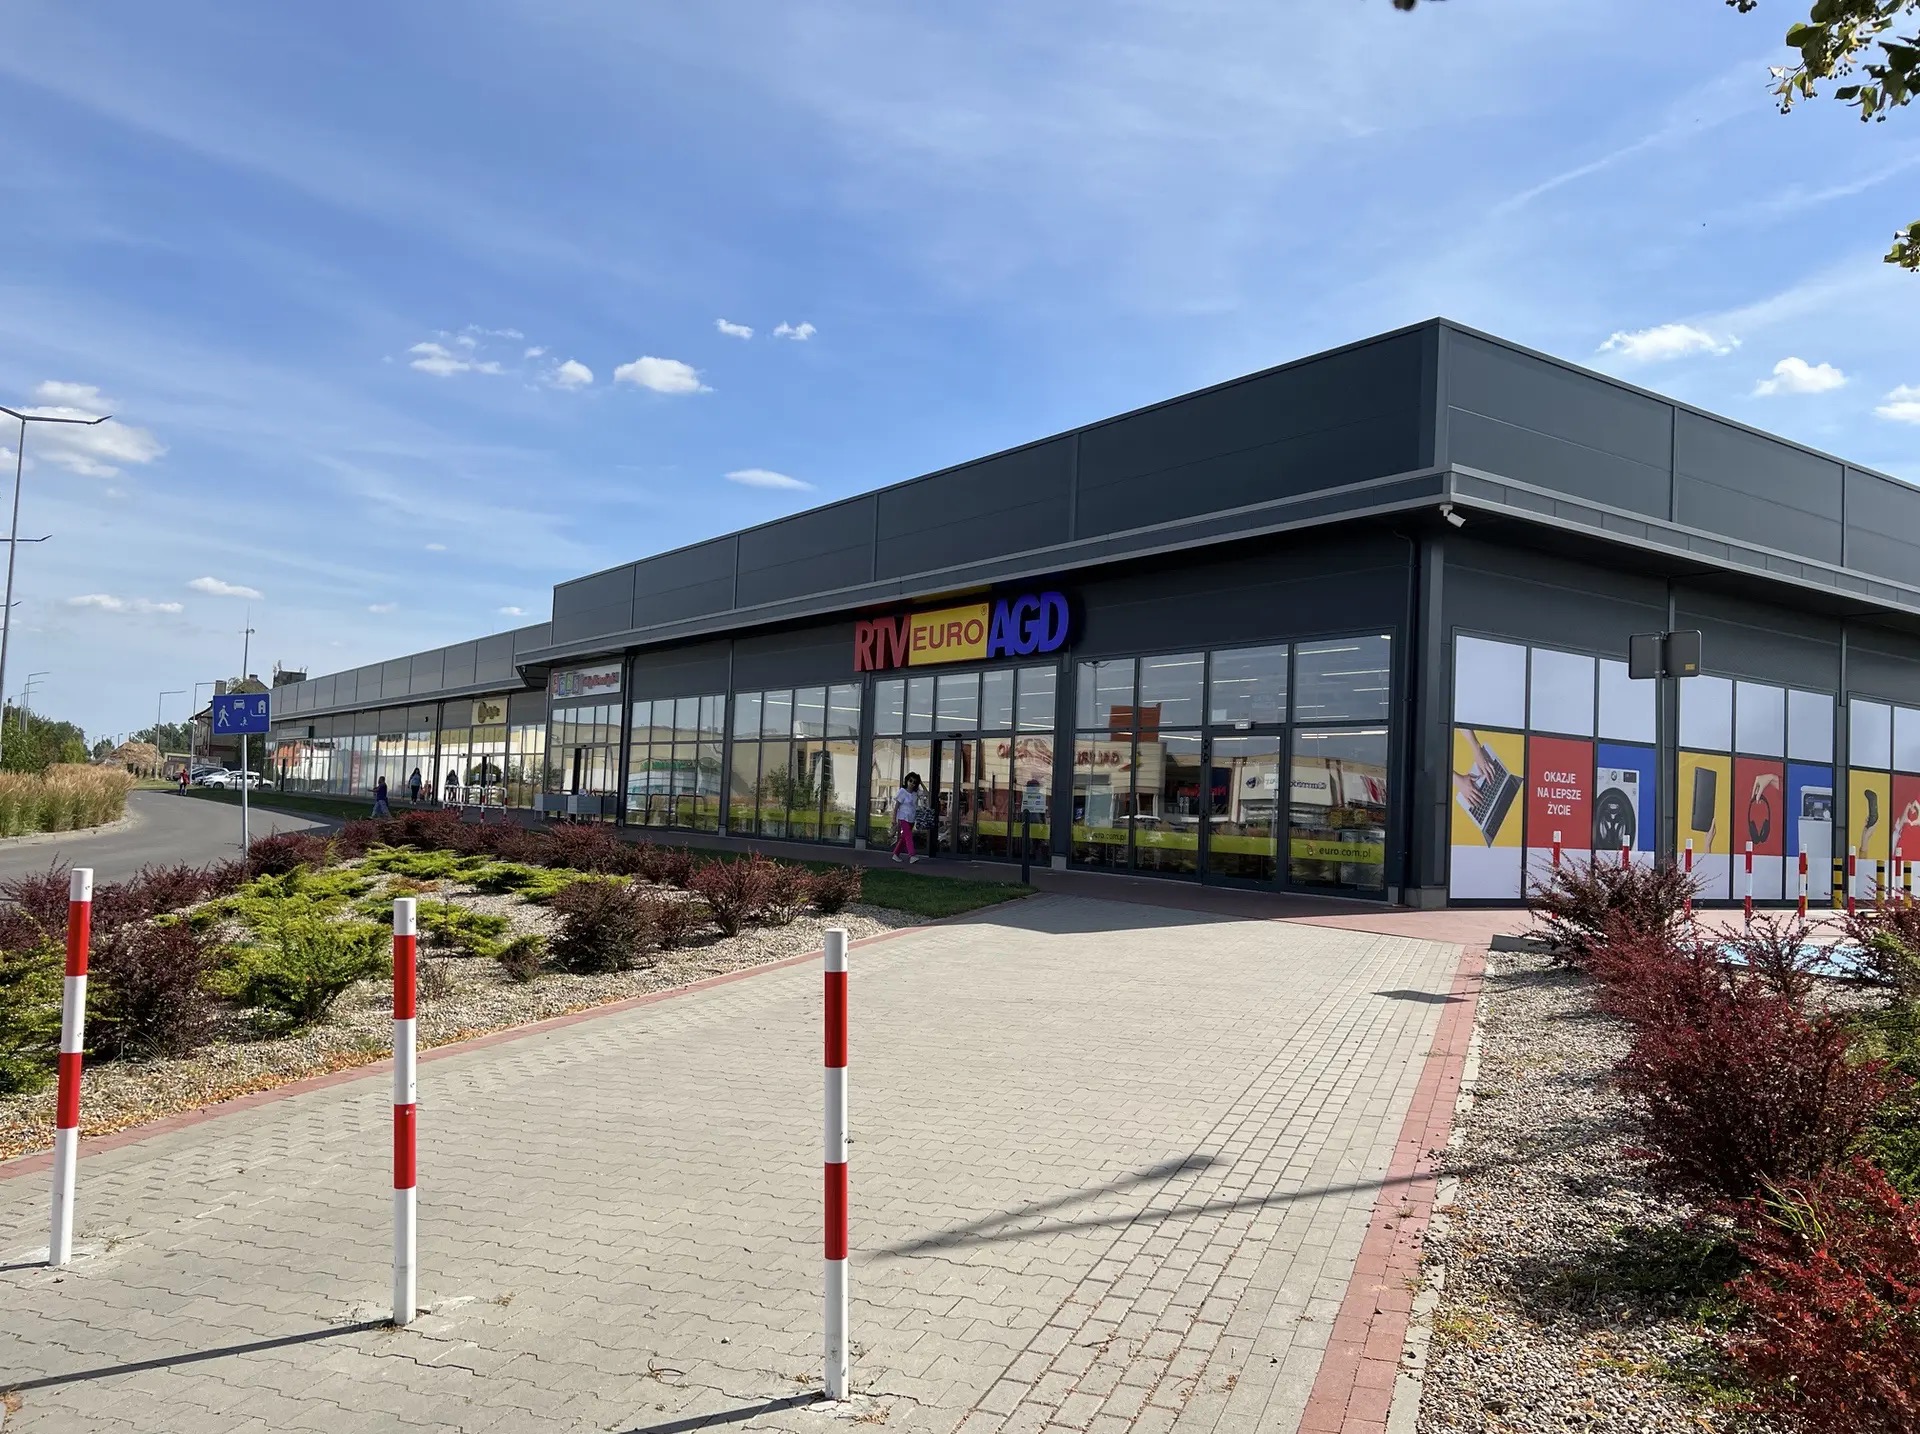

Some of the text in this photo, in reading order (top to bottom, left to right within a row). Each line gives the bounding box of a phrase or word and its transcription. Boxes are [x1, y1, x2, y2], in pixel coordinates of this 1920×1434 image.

[854, 591, 1070, 672] RTV EURO AGD
[1543, 770, 1576, 784] OKAZJE
[1537, 786, 1582, 801] NA LEPSZE
[1547, 801, 1572, 816] ŻYCIE
[1319, 846, 1371, 860] euro.com.pl
